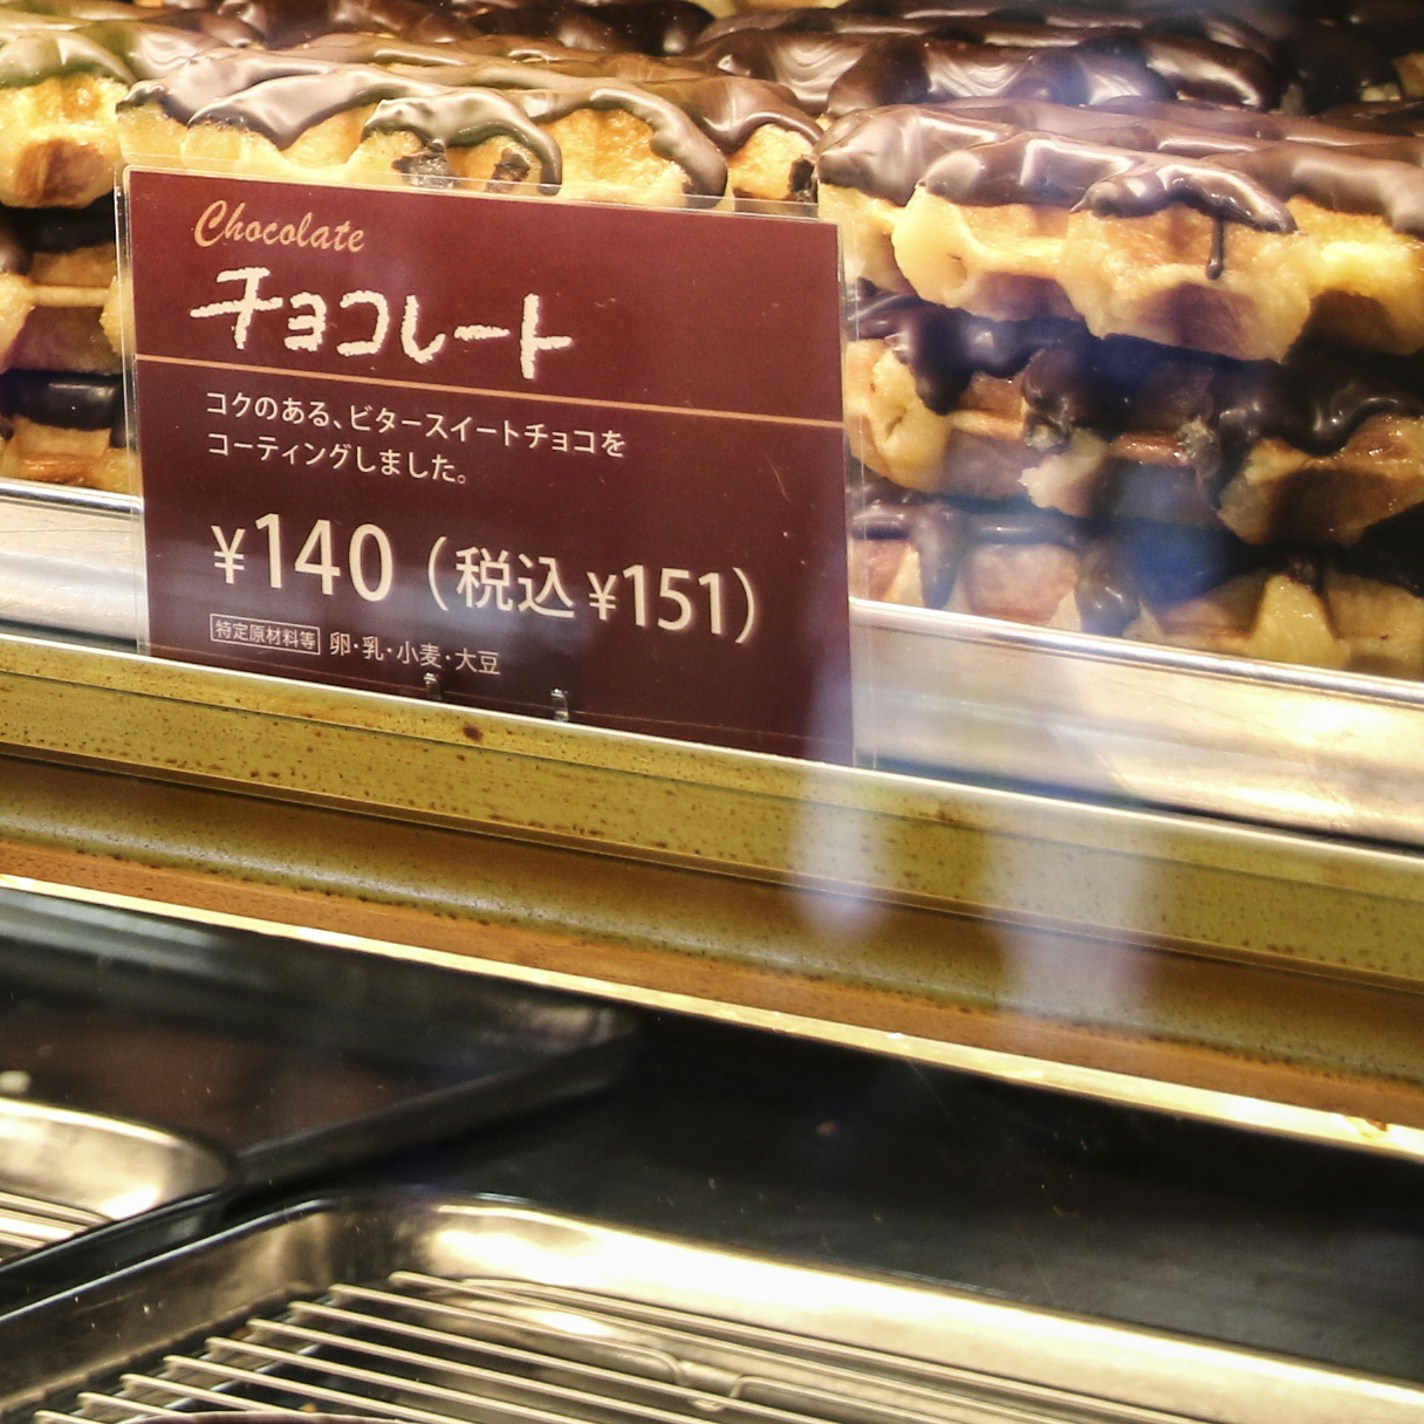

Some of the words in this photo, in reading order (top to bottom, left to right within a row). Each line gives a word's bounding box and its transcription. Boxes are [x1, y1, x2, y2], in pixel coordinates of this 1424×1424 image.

[193, 199, 366, 254] Chocolate
[190, 266, 573, 380] チョコレート
[205, 391, 626, 458] コクのある、ビタースイートチョコを
[207, 431, 466, 485] コーティングしました。
[210, 512, 394, 603] ¥140
[215, 620, 317, 651] 特定原材料等
